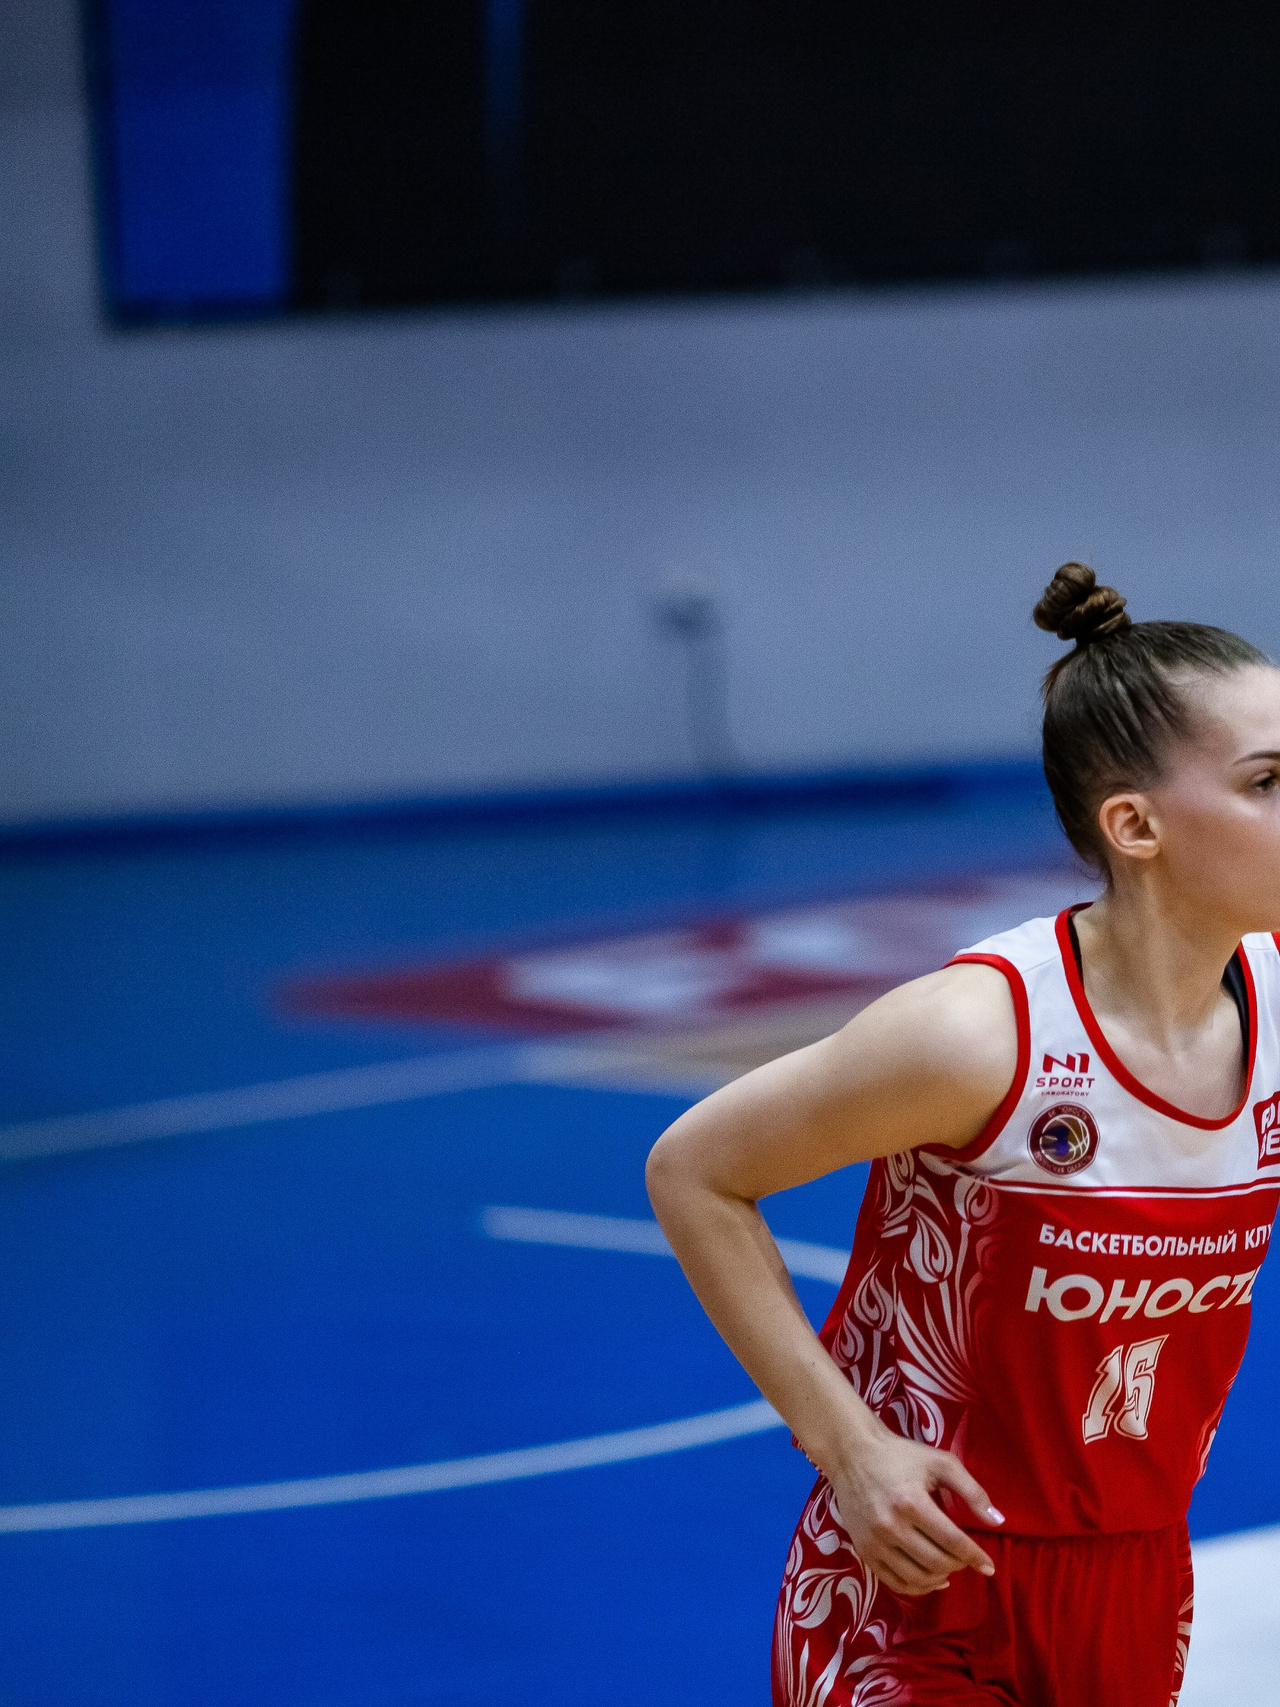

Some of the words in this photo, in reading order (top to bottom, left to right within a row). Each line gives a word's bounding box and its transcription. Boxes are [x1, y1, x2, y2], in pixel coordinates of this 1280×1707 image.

[1036, 1076, 1096, 1089] SPORT
[1039, 1223, 1237, 1256] БАСКЕТБОЛЬНЫЙ
[1081, 1333, 1170, 1445] 15
